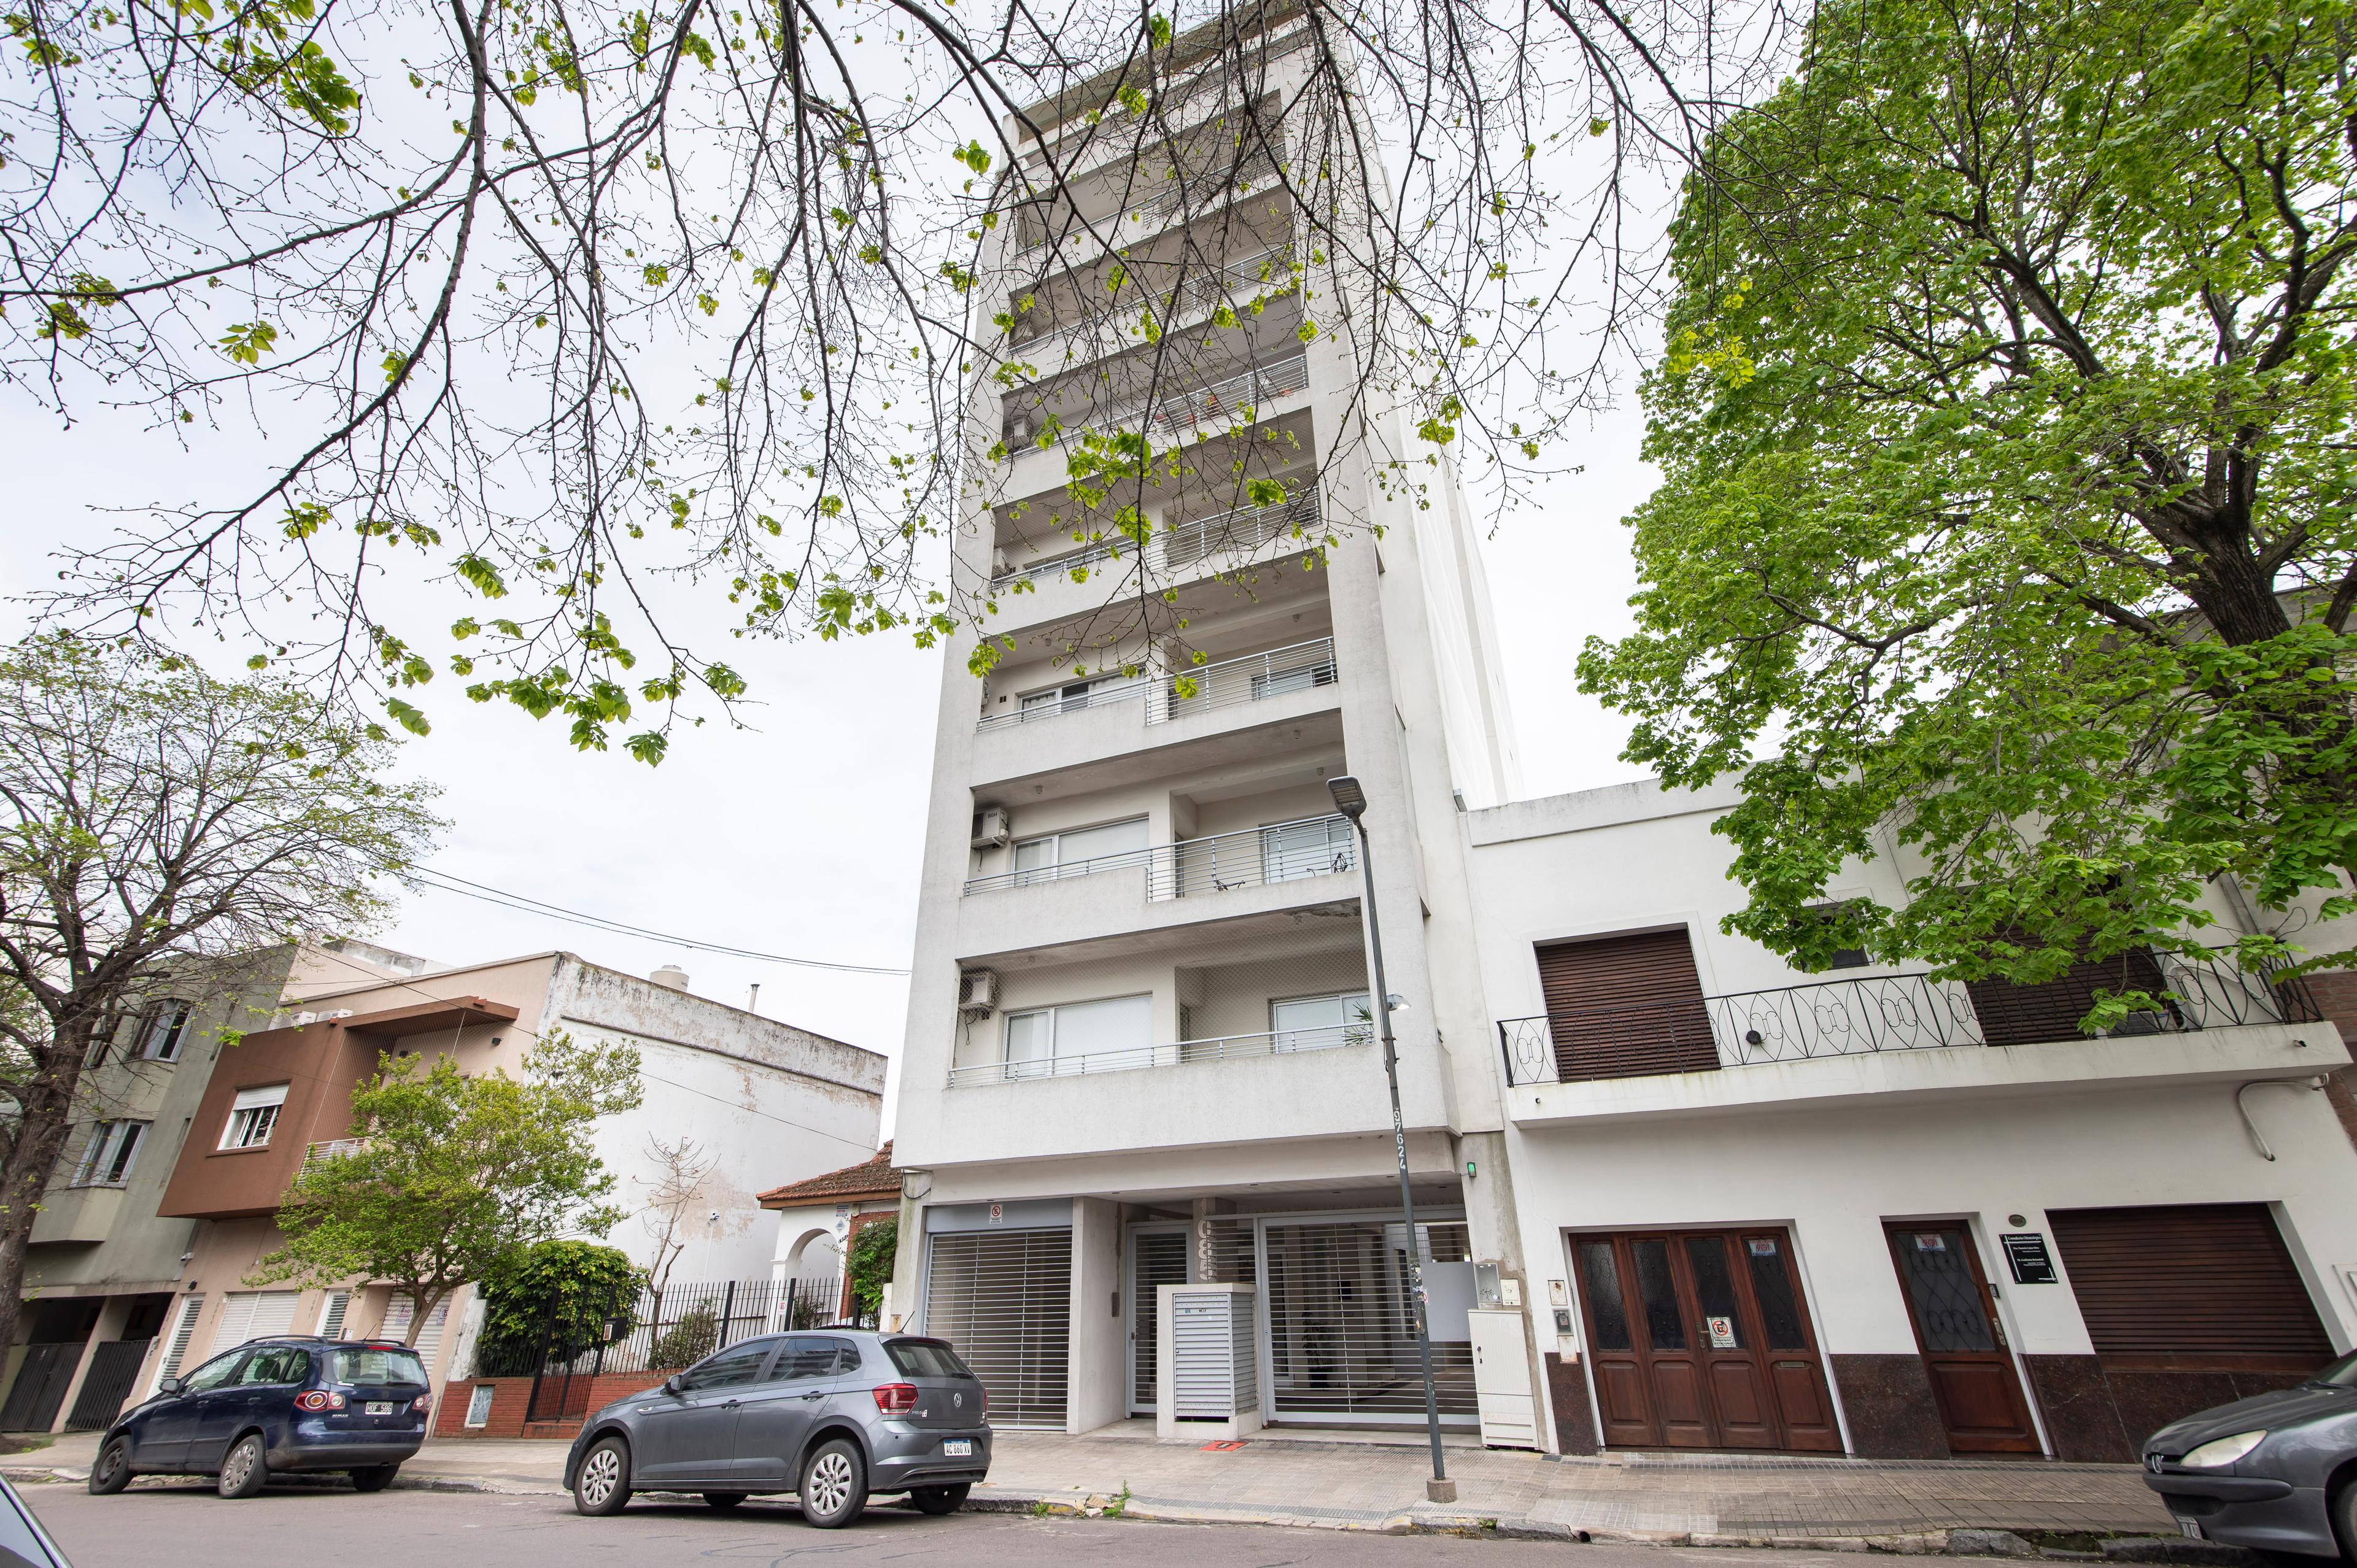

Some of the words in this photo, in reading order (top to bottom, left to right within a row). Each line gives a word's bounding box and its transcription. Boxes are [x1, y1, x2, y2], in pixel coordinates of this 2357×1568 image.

[1394, 1110, 1406, 1170] 97624
[946, 1445, 953, 1454] AC
[953, 1445, 963, 1454] 860
